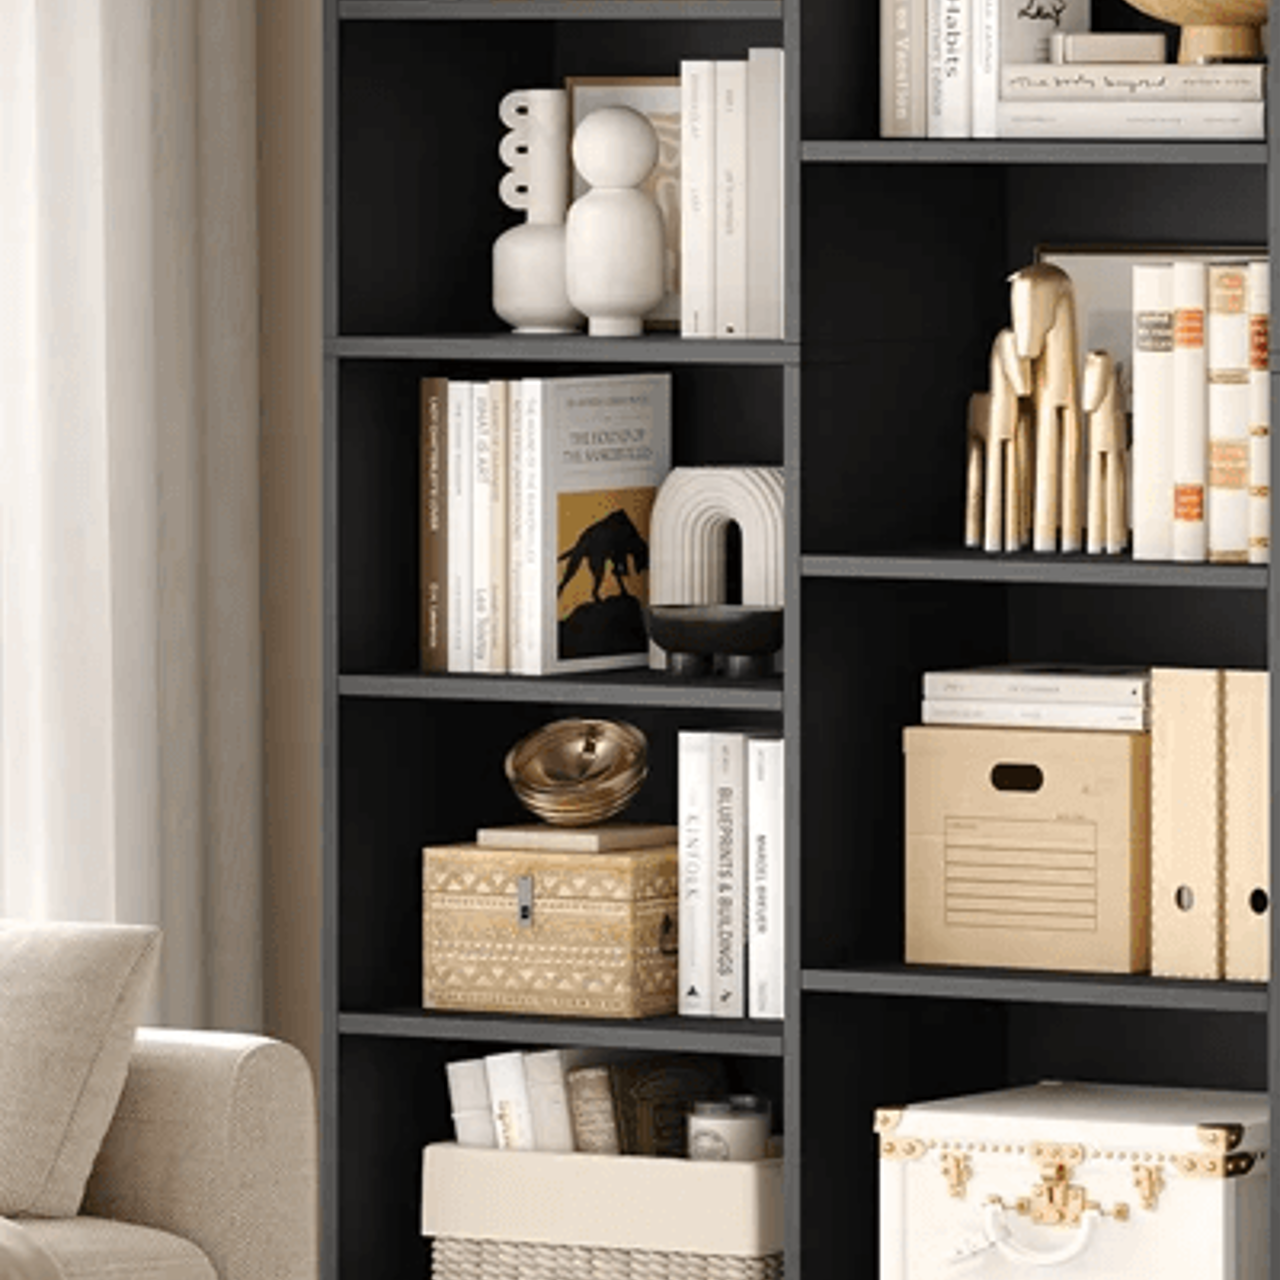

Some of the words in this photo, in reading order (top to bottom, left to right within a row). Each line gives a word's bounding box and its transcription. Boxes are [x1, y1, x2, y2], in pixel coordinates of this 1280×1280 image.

[895, 37, 911, 120] Vacation
[477, 588, 490, 613] Leo
[718, 786, 733, 877] BLUEPRINTS
[718, 881, 733, 893] &
[718, 895, 733, 976] BUILDINGS
